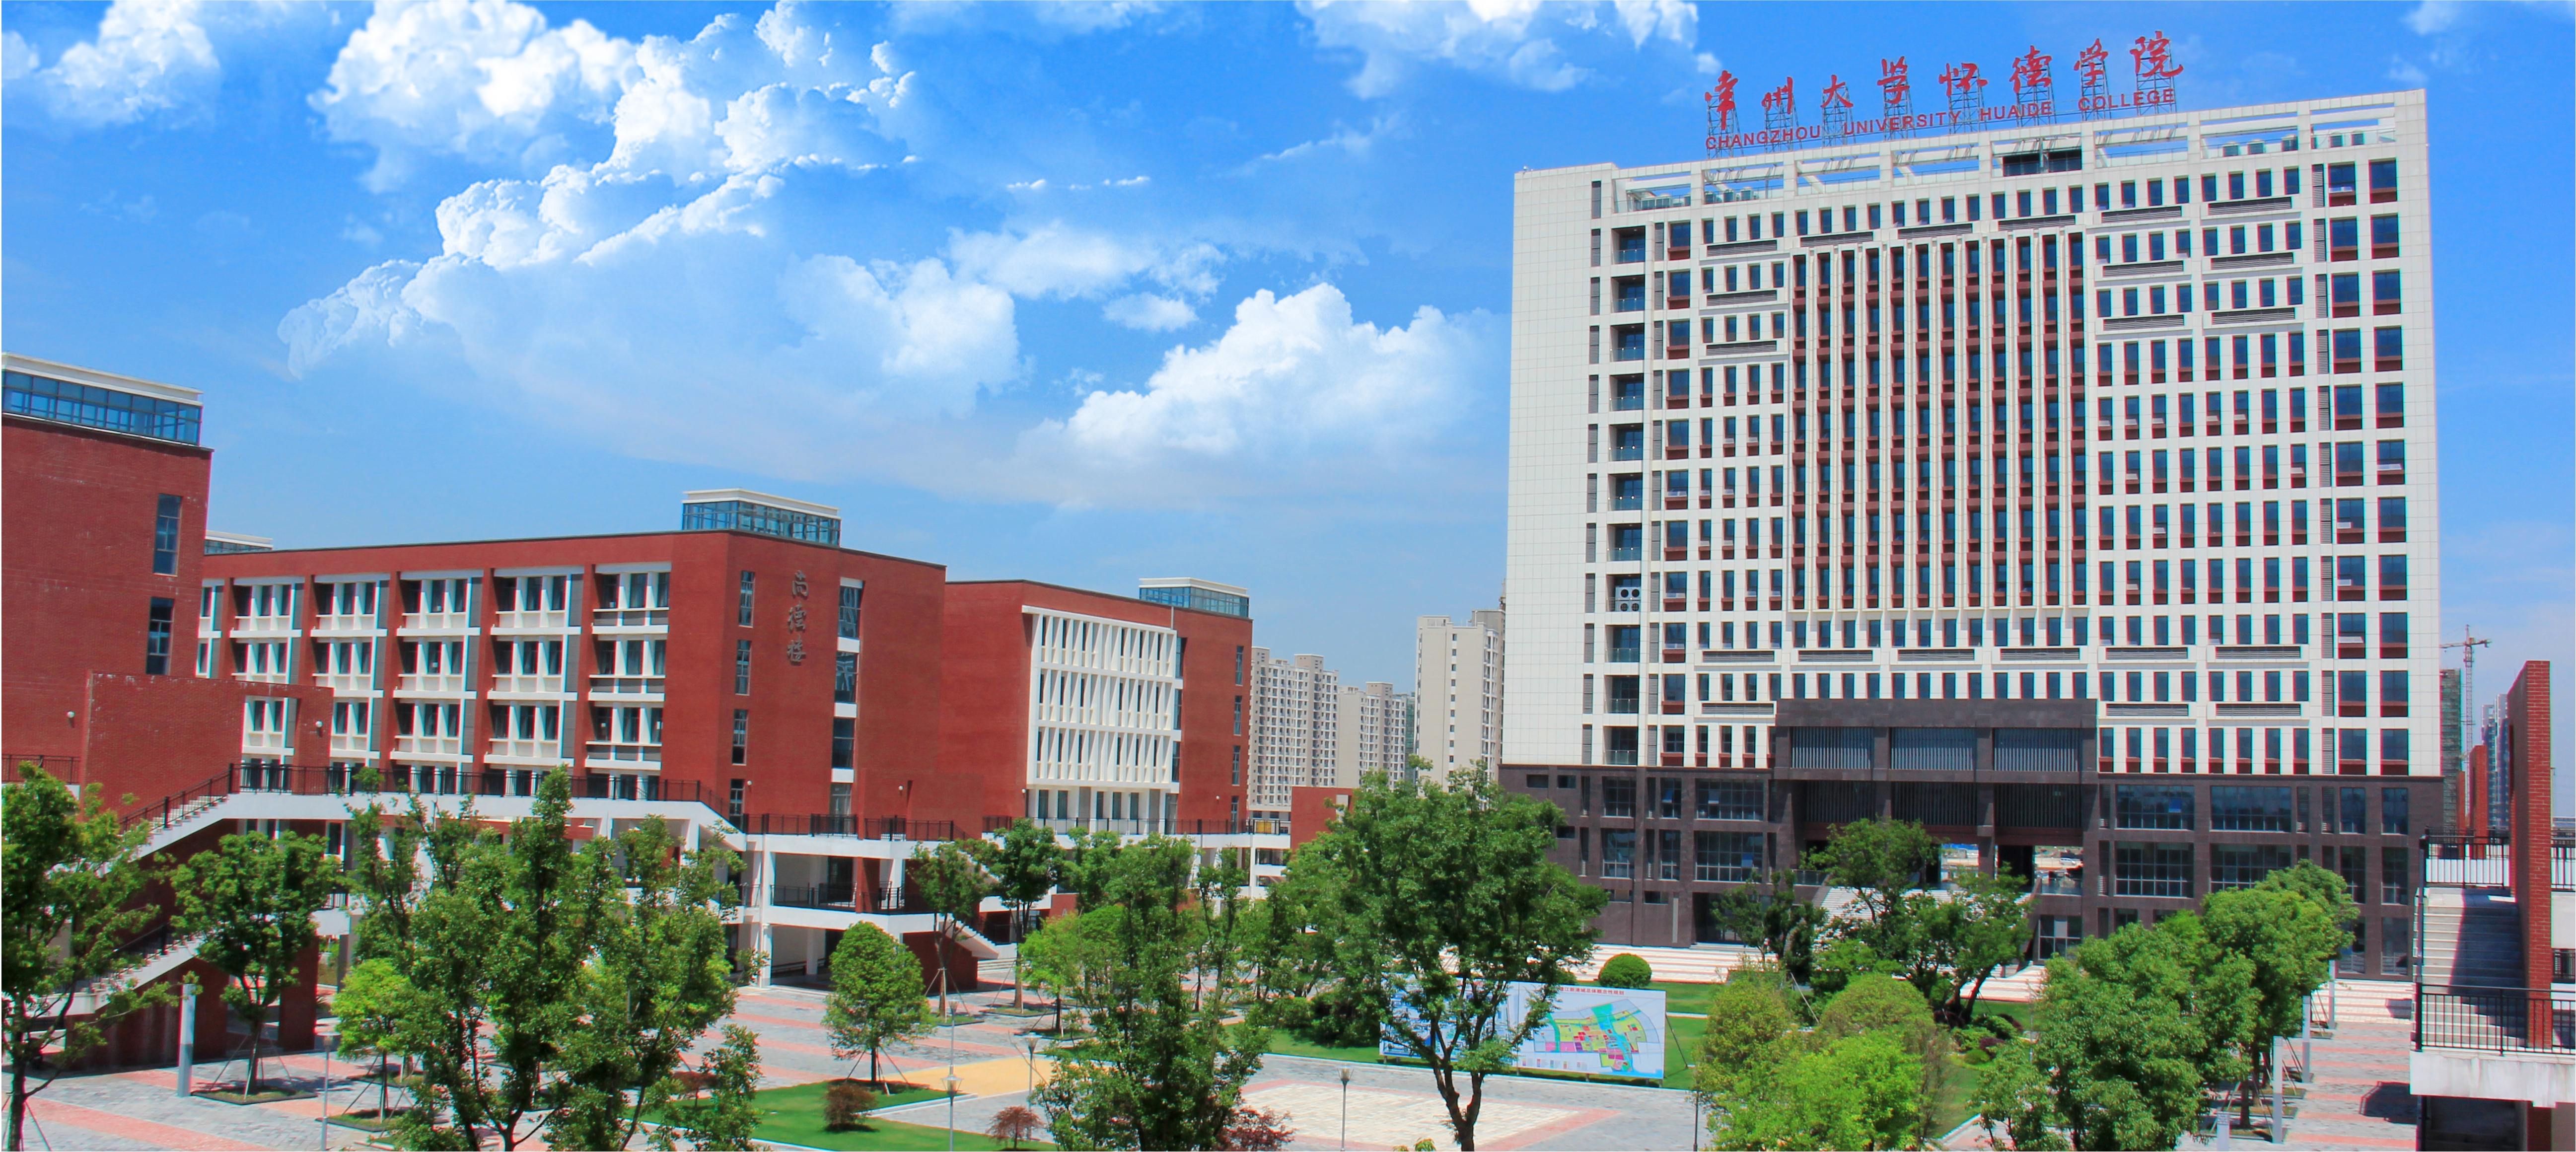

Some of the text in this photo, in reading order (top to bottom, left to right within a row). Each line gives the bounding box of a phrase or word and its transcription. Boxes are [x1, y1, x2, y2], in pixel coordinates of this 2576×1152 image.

[1705, 31, 2184, 129] 常州大学怀德学院
[1705, 88, 2175, 150] CHANGZHOU UNIVERSITY HUAIDE COLLEGE
